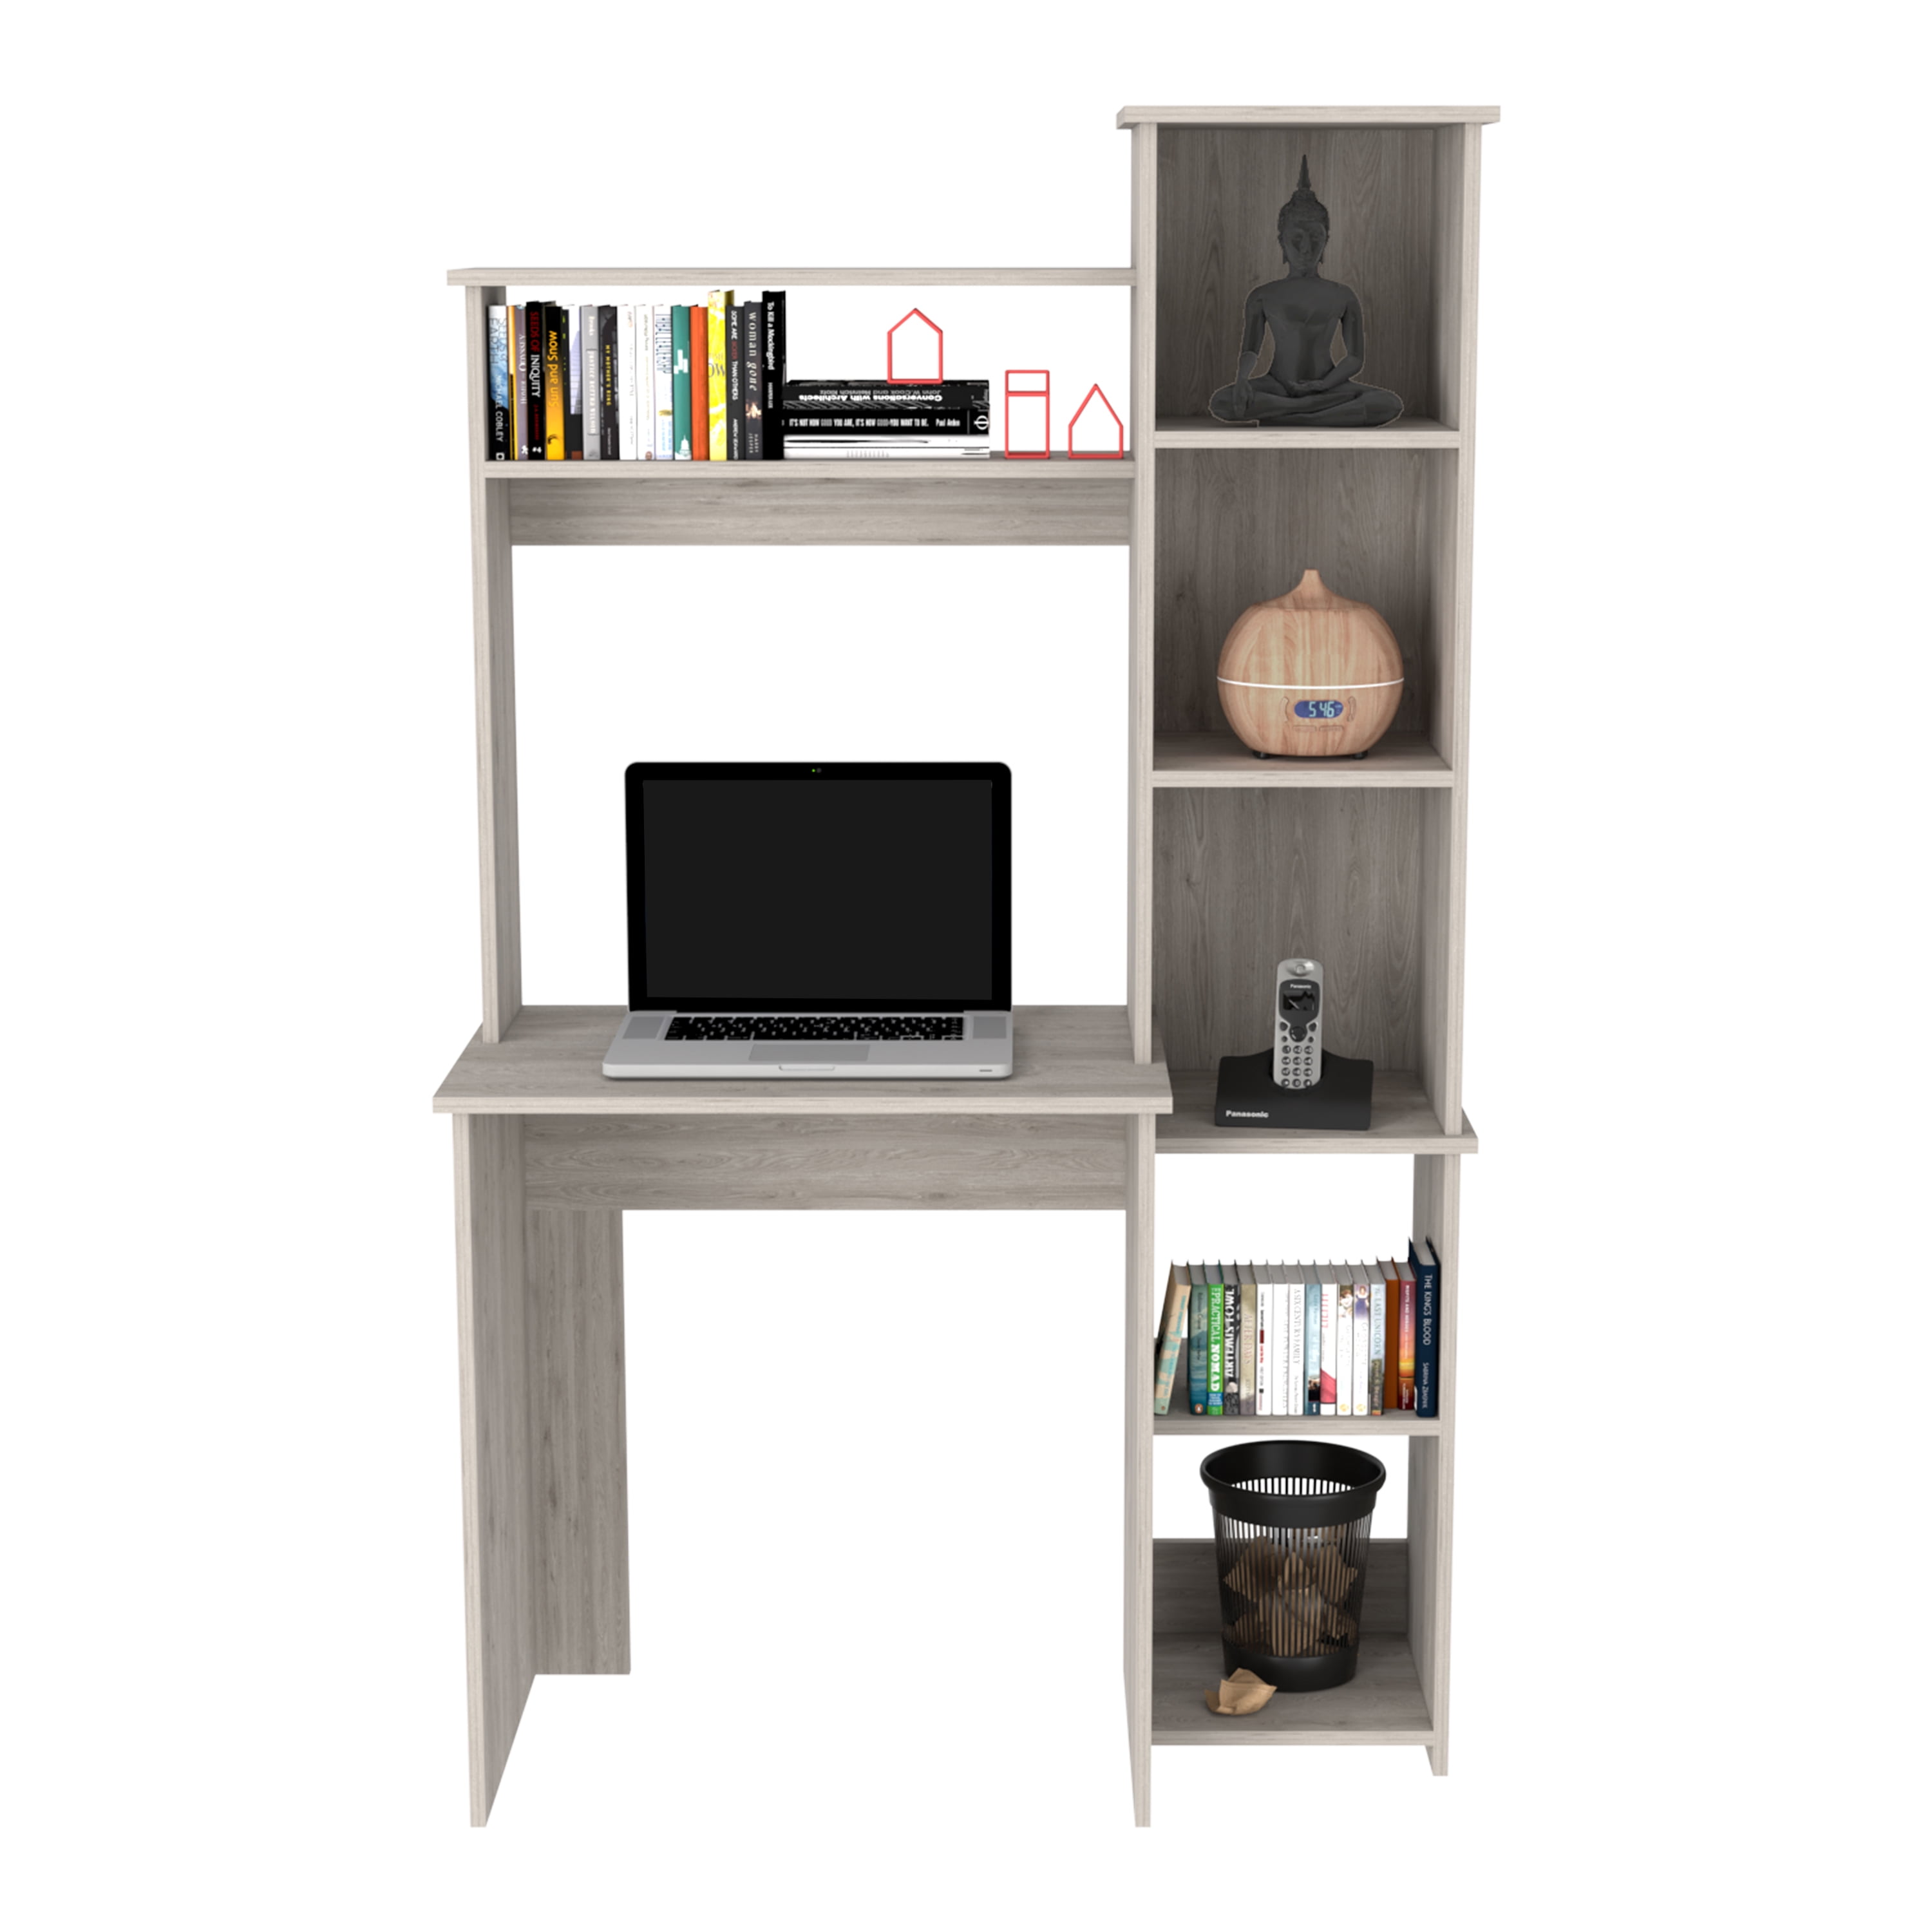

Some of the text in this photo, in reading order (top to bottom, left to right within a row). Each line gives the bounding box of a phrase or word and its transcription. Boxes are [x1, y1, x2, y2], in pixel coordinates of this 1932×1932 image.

[767, 301, 775, 310] To
[529, 311, 541, 398] SEEDS OF INIQUITY
[546, 330, 559, 408] Sun and Snow
[731, 361, 739, 377] THAN
[745, 311, 757, 392] woman gone
[766, 328, 775, 370] Mockingbird
[495, 375, 504, 442] MICHAEL COBLEY
[873, 394, 943, 402] Conversations
[1226, 1110, 1269, 1119] Panasonic
[1210, 1293, 1222, 1343] PRACTICAL
[1374, 1298, 1383, 1316] LAST
[1422, 1274, 1433, 1345] THE KING'S BLOOD
[1224, 1288, 1235, 1378] ARTEMIS FOWL
[1373, 1319, 1383, 1356] UNICORN
[1210, 1343, 1220, 1392] NOMAD
